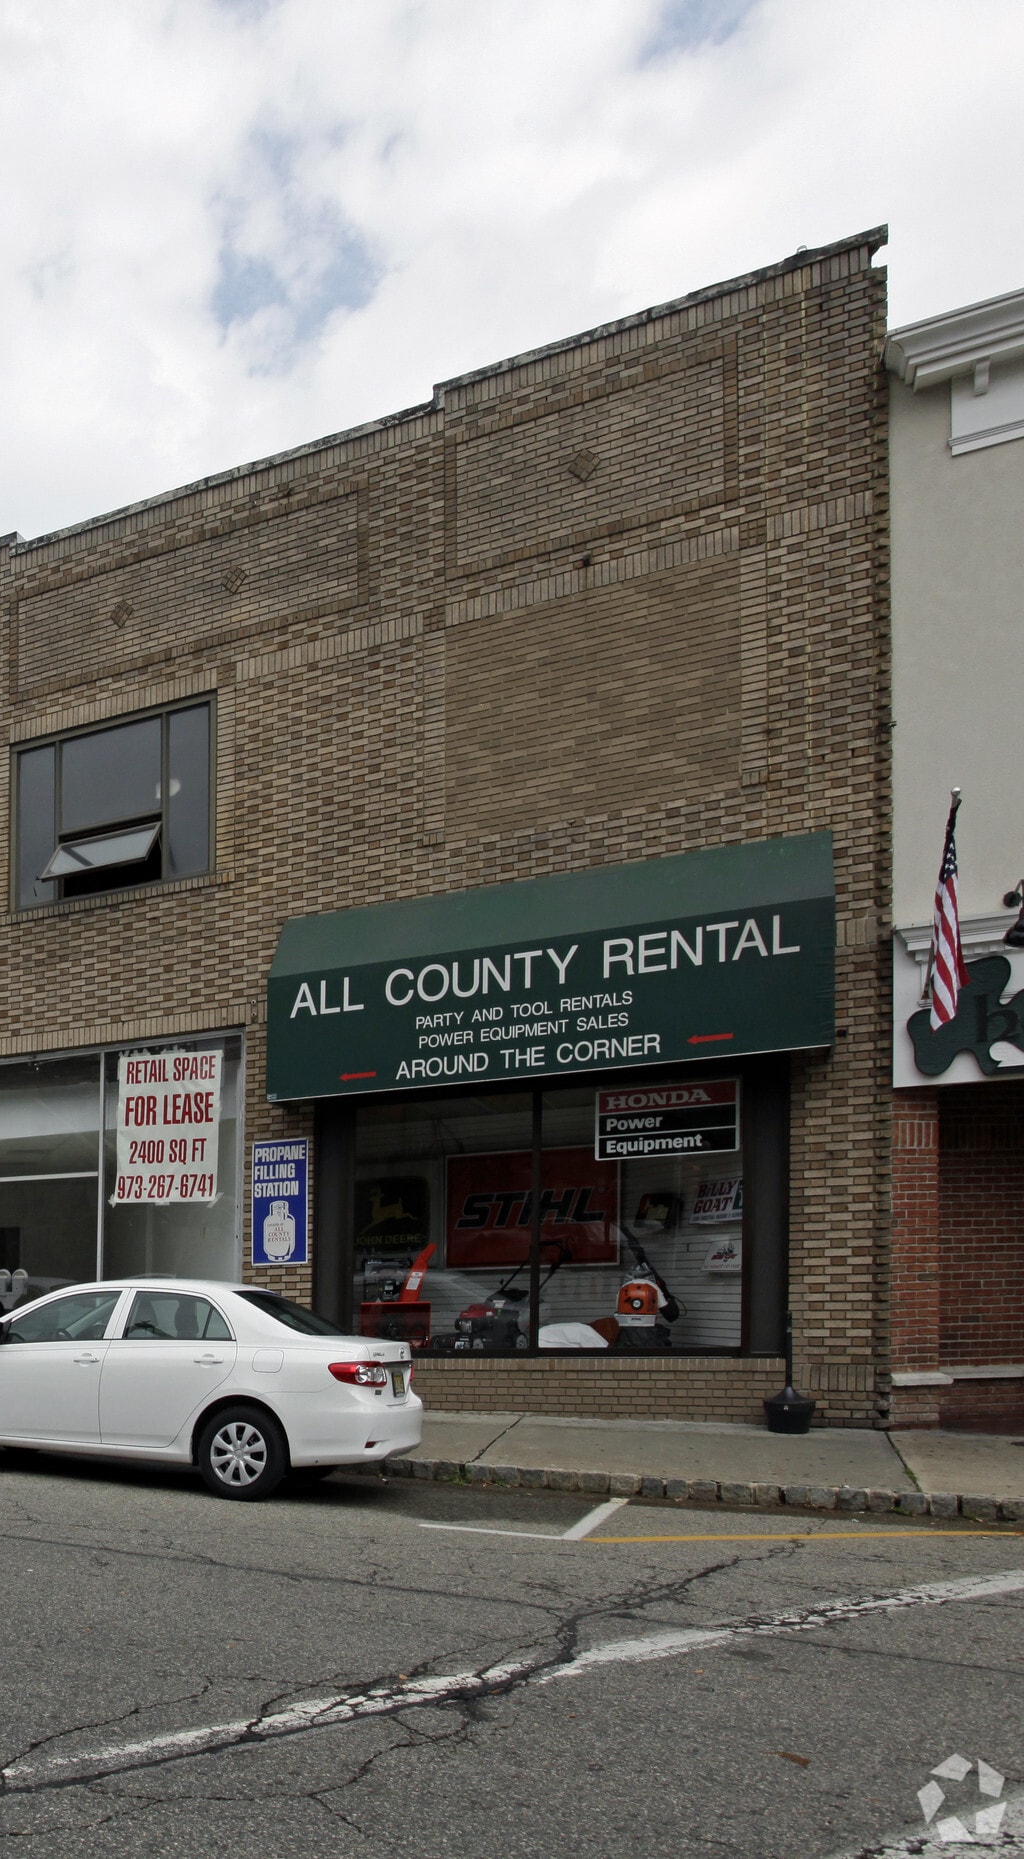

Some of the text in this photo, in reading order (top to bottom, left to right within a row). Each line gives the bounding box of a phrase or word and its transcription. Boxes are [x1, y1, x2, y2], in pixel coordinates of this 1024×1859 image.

[290, 915, 801, 1019] ALL COUNTY RENTAL
[415, 990, 633, 1029] PARTY AND TOOL RENTALS
[418, 1012, 630, 1049] POWER EQUIPMENT SALES
[127, 1055, 216, 1084] RETAIL SPACE
[396, 1033, 661, 1080] AROUND THE CORNER
[125, 1092, 214, 1126] FOR LEASE
[606, 1087, 711, 1110] HONDA
[605, 1114, 663, 1132] Power
[129, 1138, 207, 1165] 2400 SQ FT
[255, 1145, 306, 1162] PROPANE
[605, 1133, 702, 1155] Equipment
[254, 1163, 296, 1181] FILLING
[117, 1173, 214, 1200] 973-267-6741
[254, 1181, 299, 1198] STATION
[454, 1187, 608, 1230] STIHL
[693, 1196, 734, 1214] GOAT
[354, 1233, 422, 1246] JOHN DEERE
